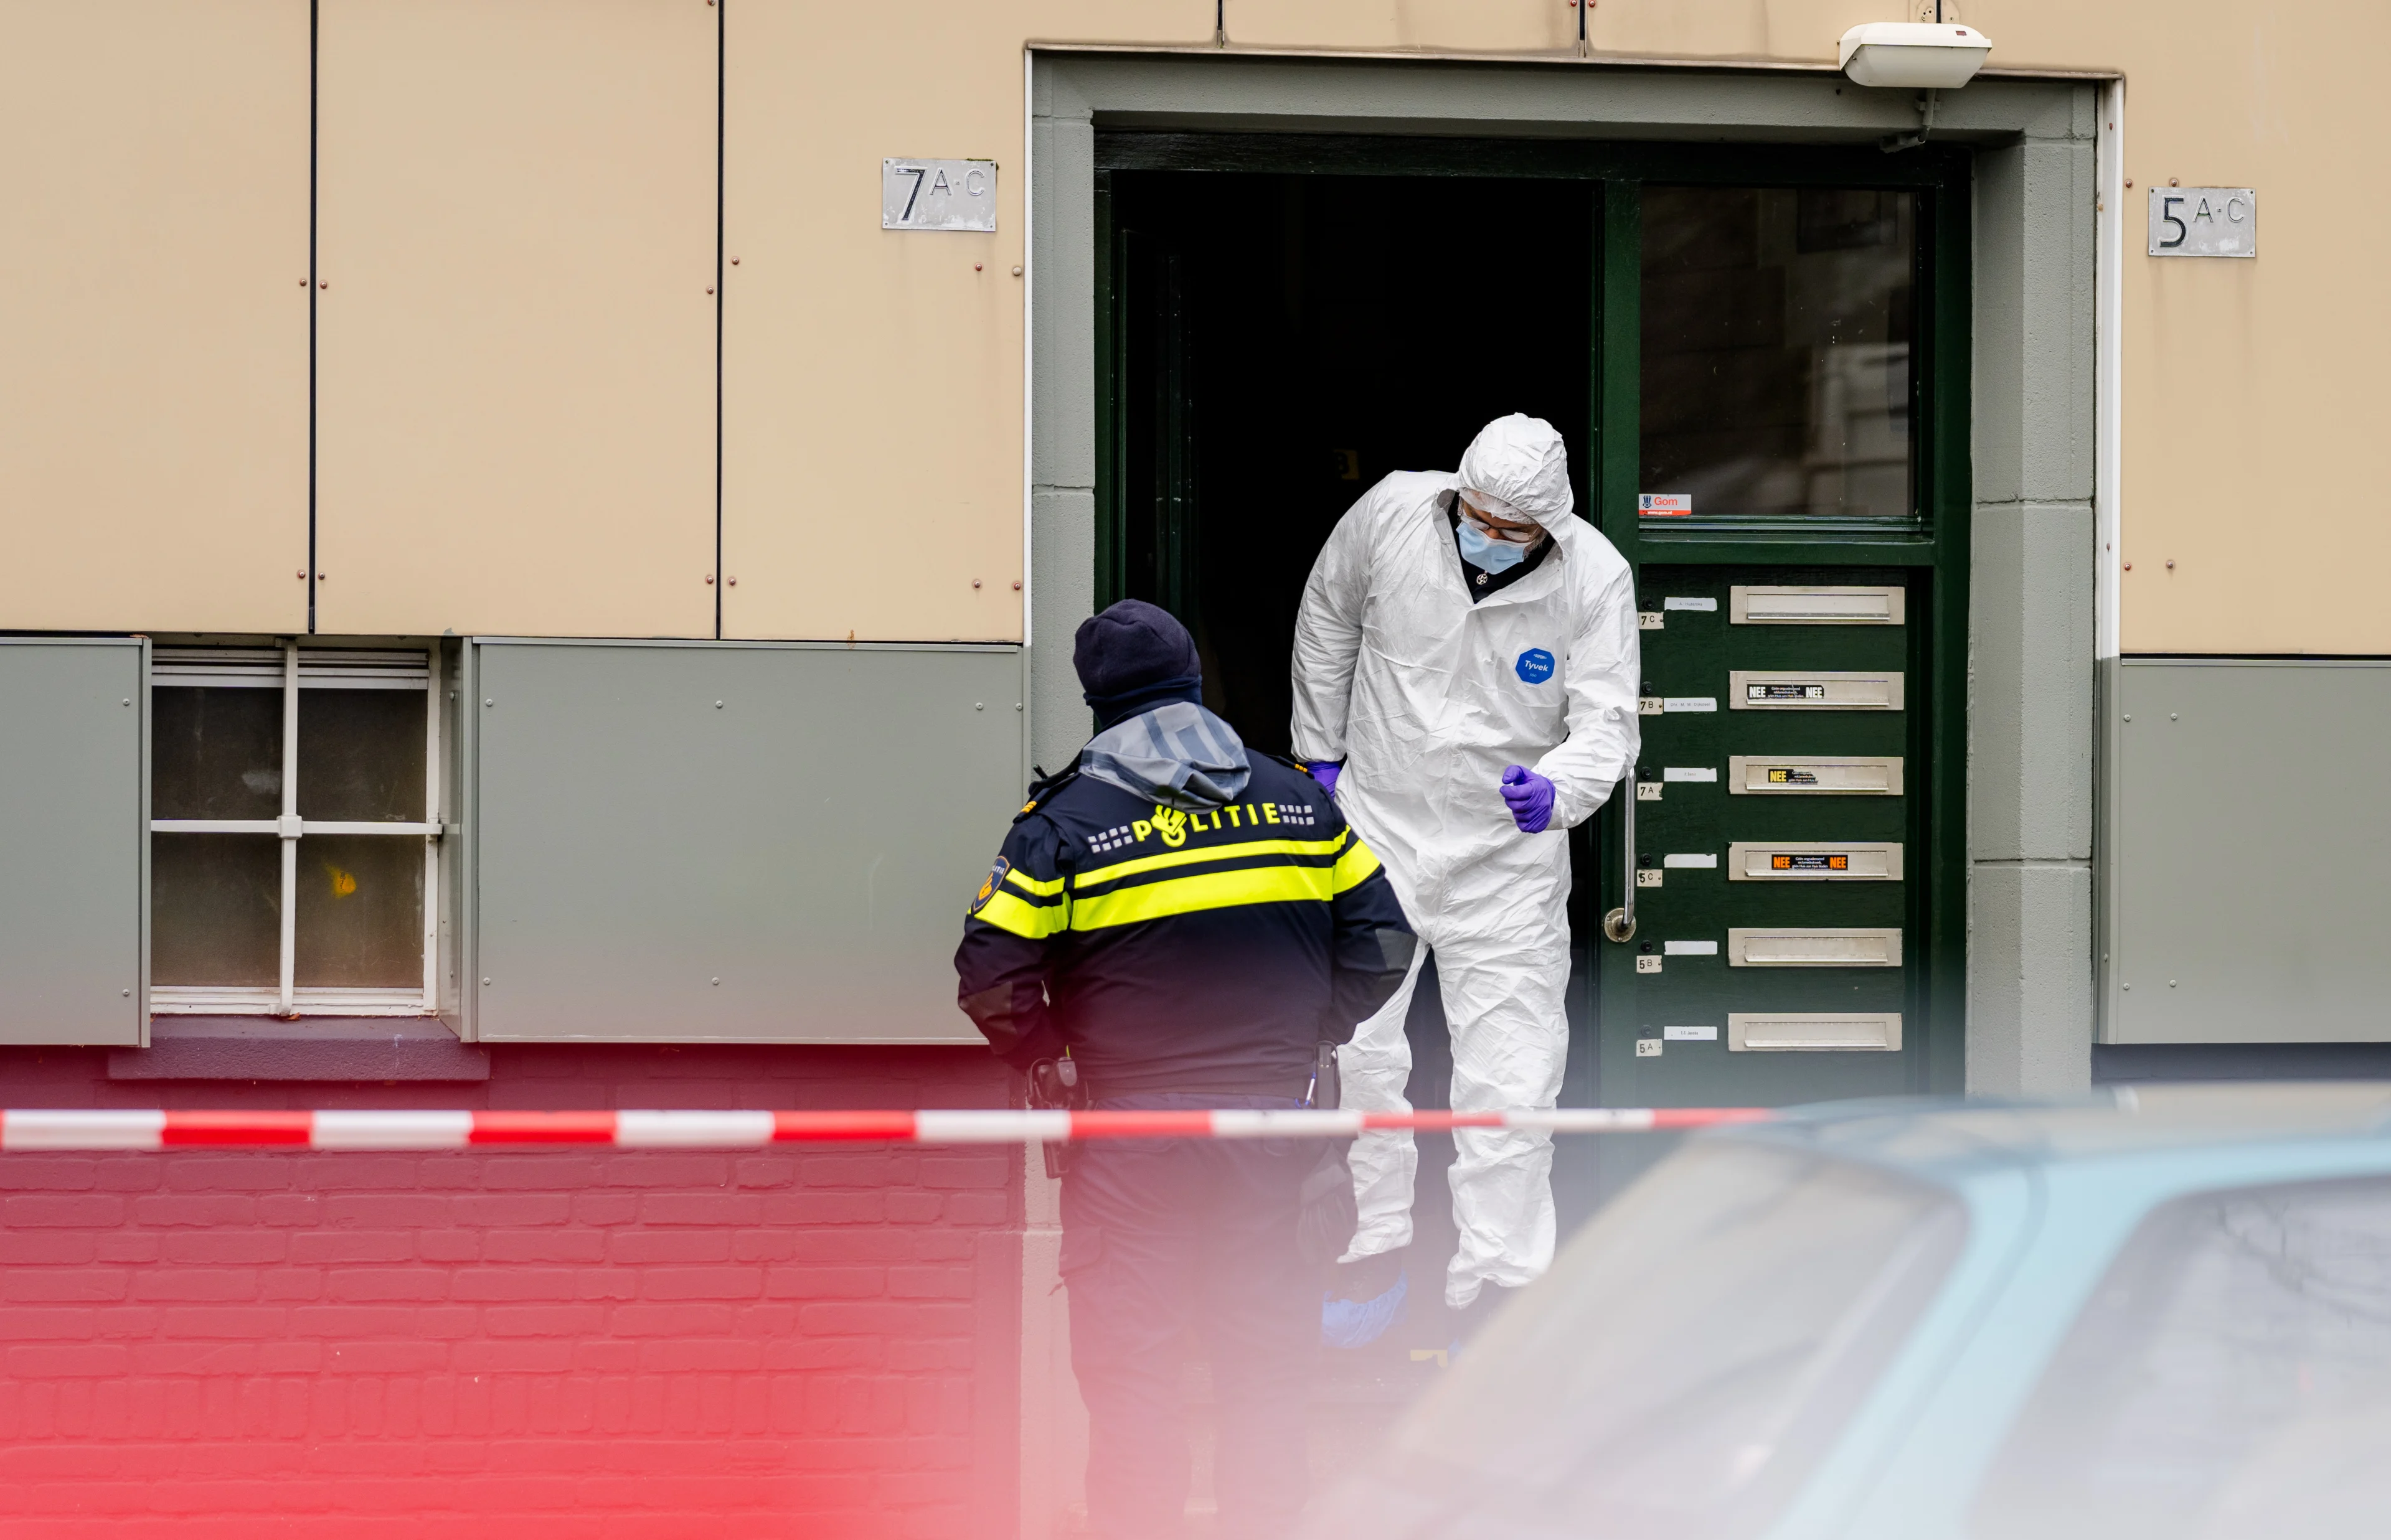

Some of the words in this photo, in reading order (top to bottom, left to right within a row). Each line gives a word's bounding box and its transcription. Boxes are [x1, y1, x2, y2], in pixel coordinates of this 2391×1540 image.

[1654, 496, 1678, 505] Gom
[1525, 659, 1549, 672] Tyvek
[1749, 686, 1766, 698] NEE
[1806, 687, 1823, 698] NEE
[1770, 771, 1786, 782] NEE
[1773, 857, 1790, 868] NEE
[1829, 857, 1846, 868] NEE
